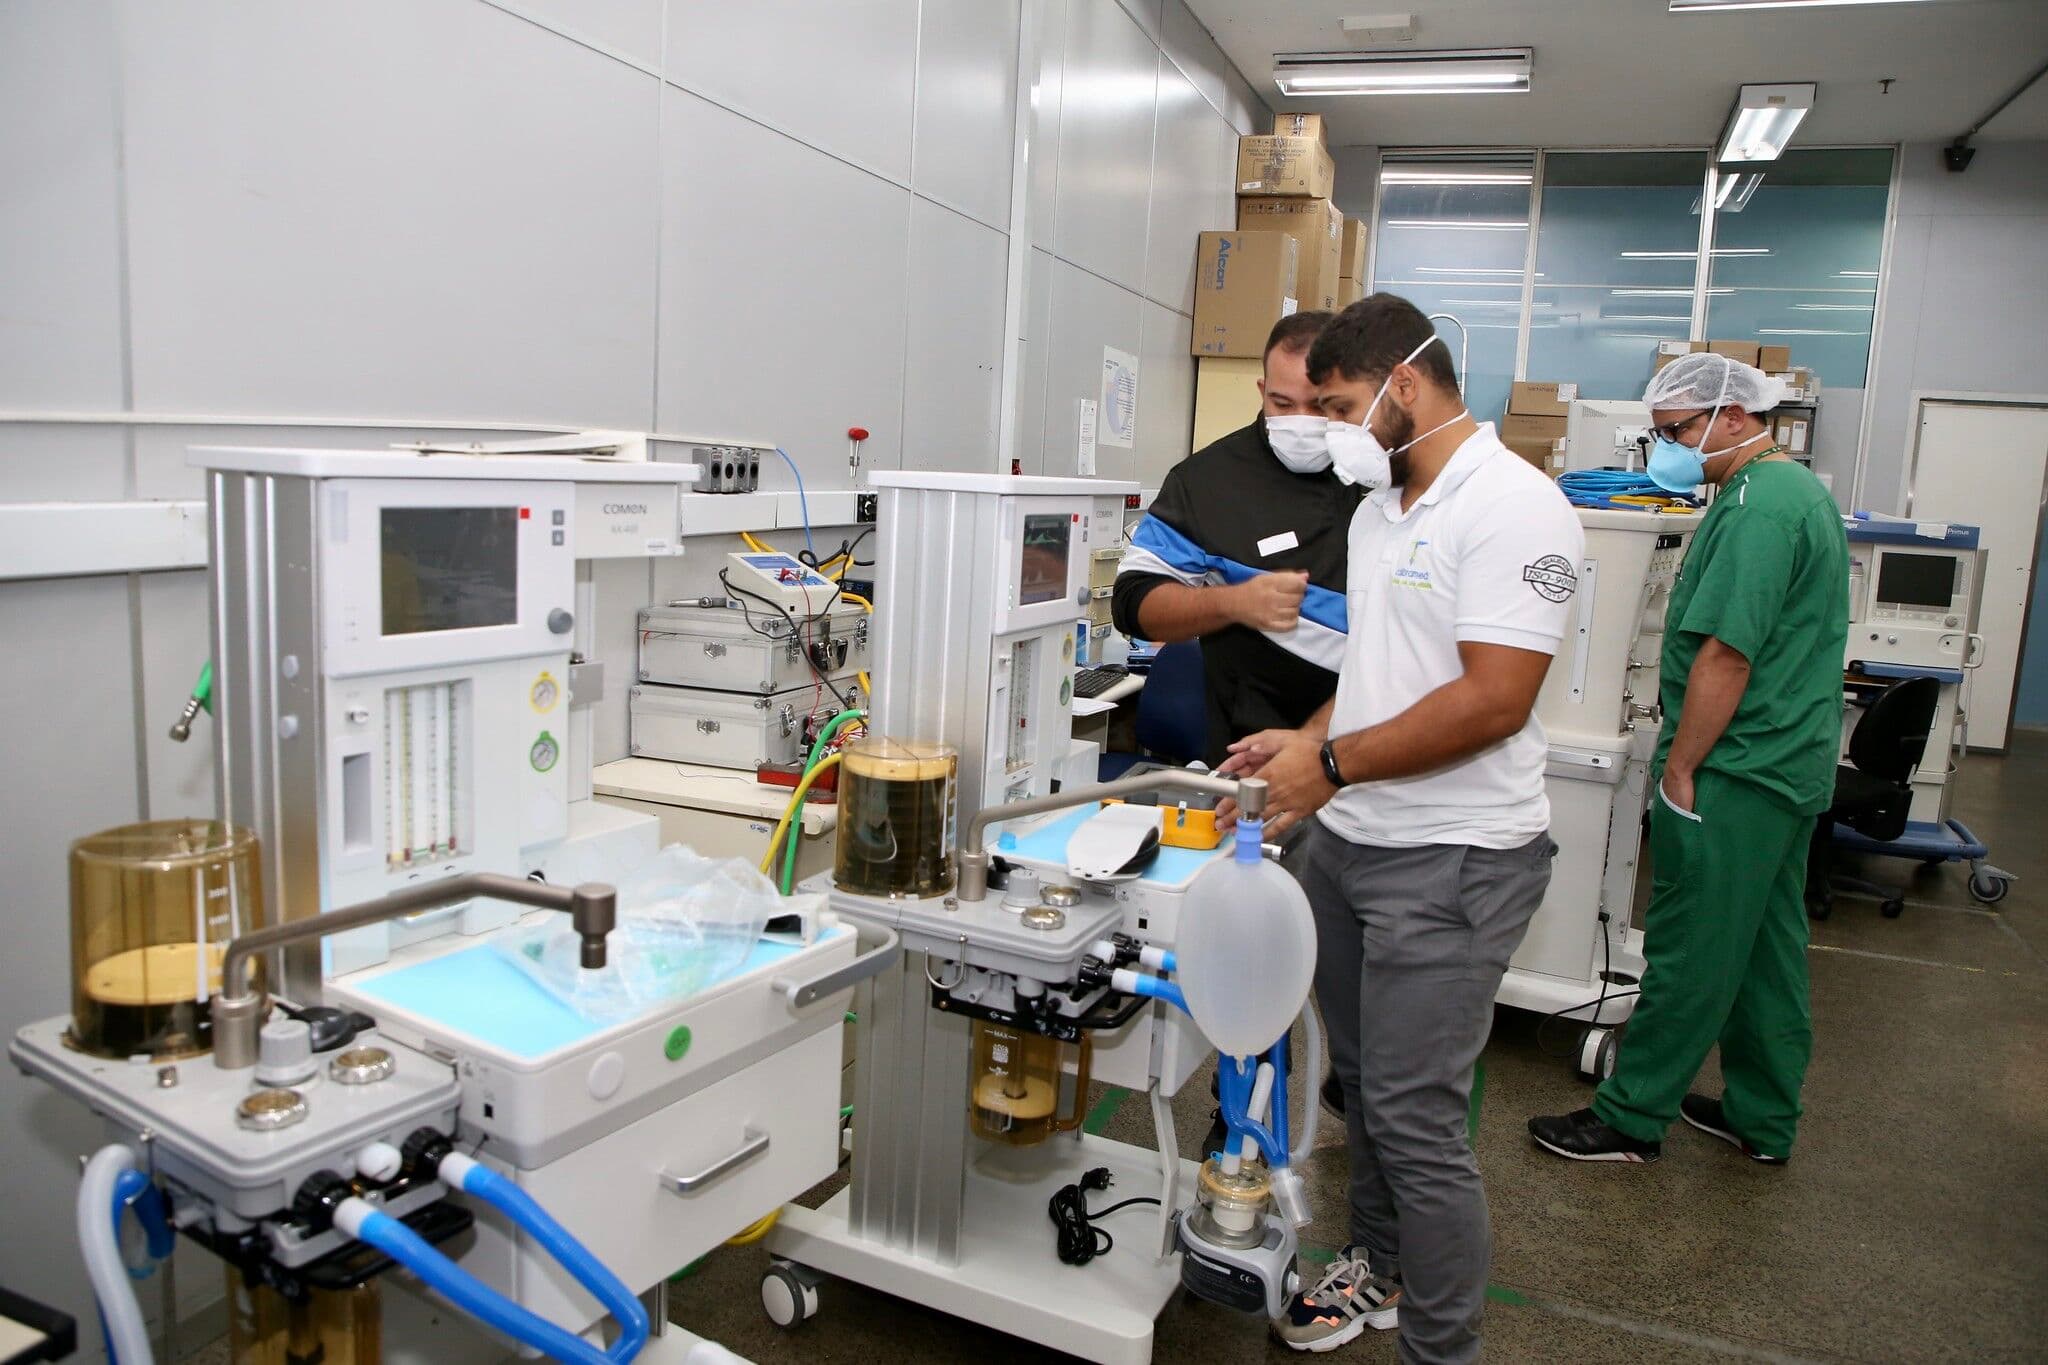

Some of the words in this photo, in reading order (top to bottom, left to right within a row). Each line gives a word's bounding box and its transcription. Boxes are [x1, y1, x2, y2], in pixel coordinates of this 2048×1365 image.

[1216, 238, 1232, 290] Alcon
[1947, 527, 1970, 535] Primus
[993, 1030, 1009, 1039] MAX
